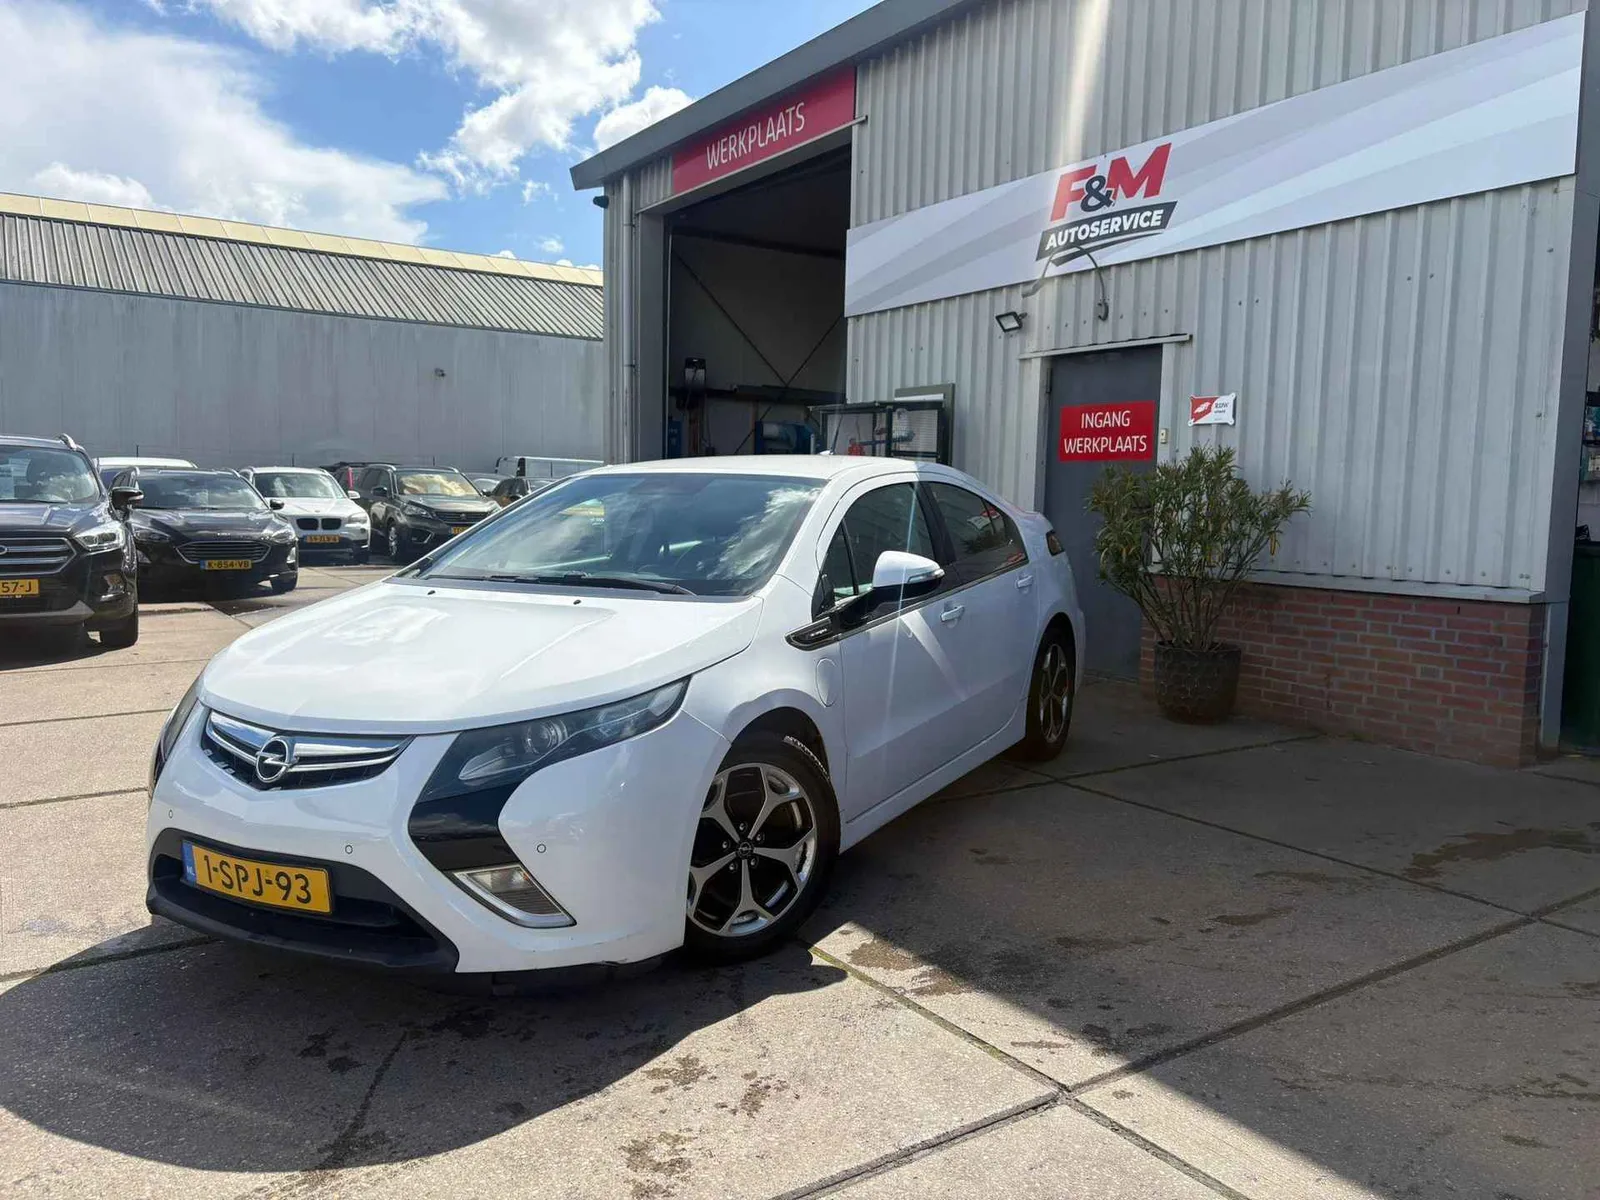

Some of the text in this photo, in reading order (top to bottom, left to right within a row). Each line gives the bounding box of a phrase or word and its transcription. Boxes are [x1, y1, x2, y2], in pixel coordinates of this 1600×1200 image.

[706, 102, 805, 170] WERKPLAATS
[1050, 142, 1172, 222] F&M
[1045, 209, 1164, 251] AUTOSERVICE
[1081, 410, 1131, 429] INGANG
[1064, 435, 1147, 454] WERKPLAATS
[203, 855, 312, 904] 1-SPJ-93
